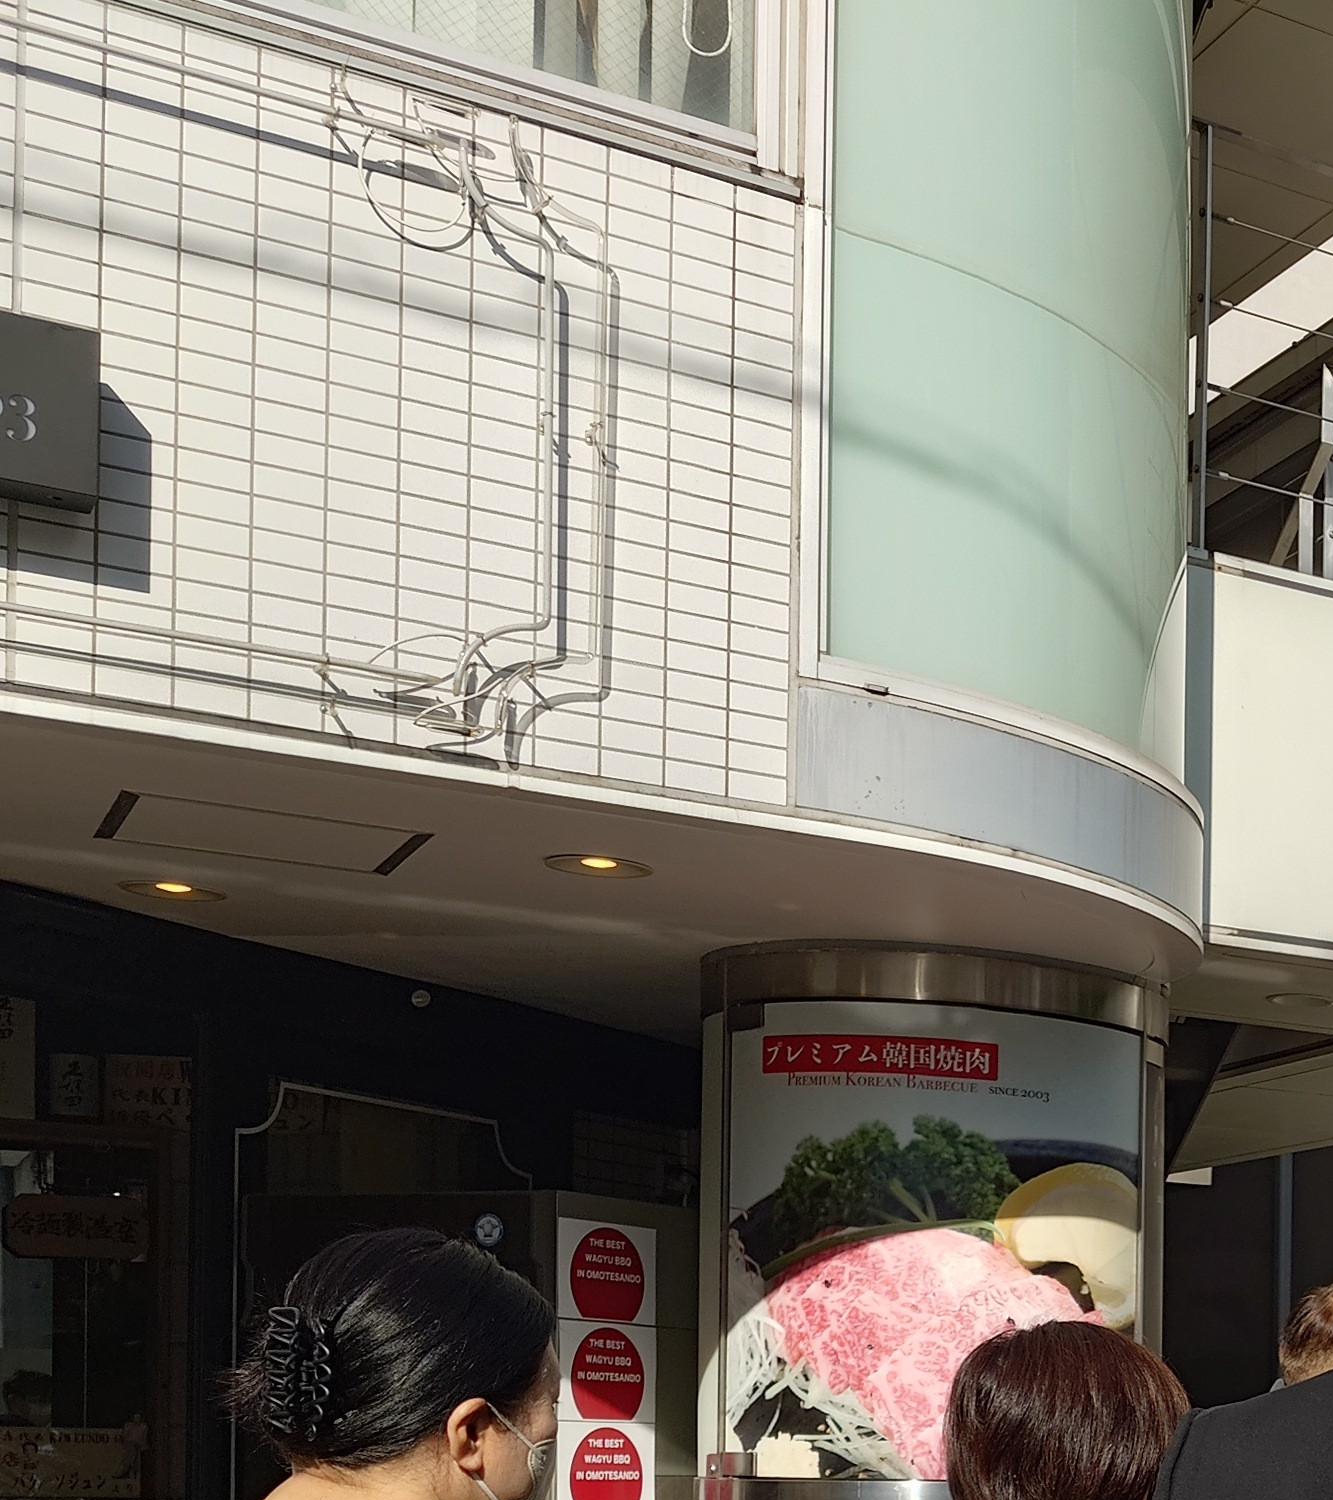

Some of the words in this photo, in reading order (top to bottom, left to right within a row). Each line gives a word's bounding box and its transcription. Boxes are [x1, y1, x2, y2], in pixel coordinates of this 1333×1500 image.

[766, 1041, 990, 1075] プレミアム韓国焼肉
[1020, 1089, 1050, 1103] 2003
[589, 1238, 604, 1248] THE
[606, 1240, 626, 1250] BEST
[585, 1253, 614, 1264] WAGYU
[615, 1256, 632, 1267] BBQ
[576, 1269, 585, 1278] IN
[586, 1270, 641, 1284] OMOTESANDO
[589, 1339, 604, 1348] THE
[606, 1340, 626, 1350] BEST
[585, 1354, 613, 1365] WAGYU
[614, 1356, 632, 1367] BBQ
[577, 1371, 585, 1380] IN
[586, 1371, 641, 1383] OMOTESANDO
[588, 1438, 603, 1448] THE
[604, 1438, 625, 1449] BEST
[584, 1454, 612, 1464] WAGYU
[613, 1454, 631, 1465] BBQ
[575, 1470, 584, 1480] IN
[585, 1470, 640, 1481] OMOTESANDO
